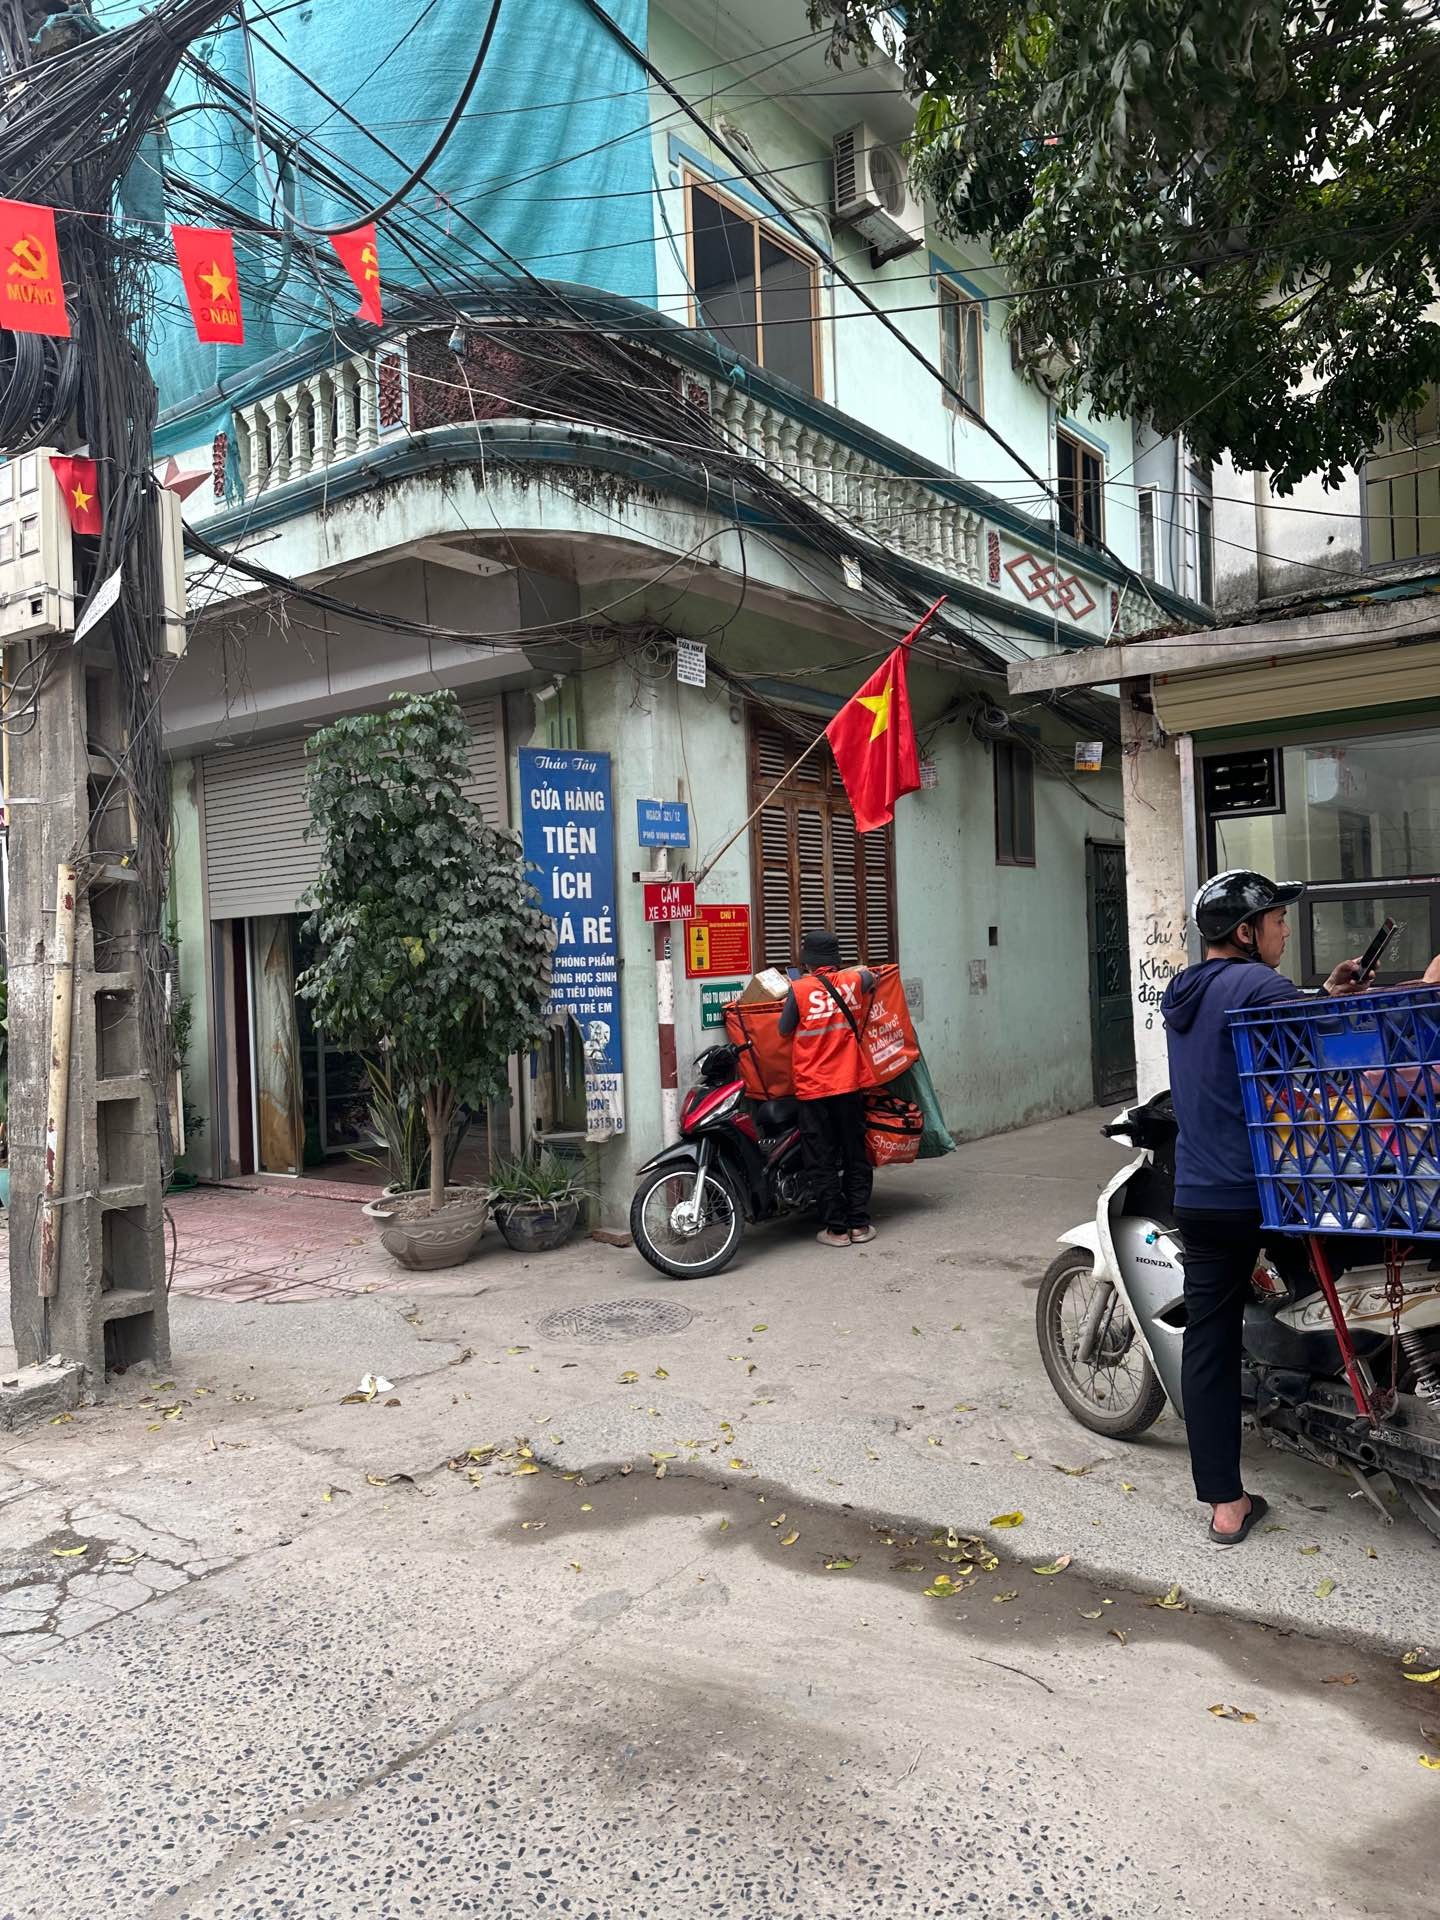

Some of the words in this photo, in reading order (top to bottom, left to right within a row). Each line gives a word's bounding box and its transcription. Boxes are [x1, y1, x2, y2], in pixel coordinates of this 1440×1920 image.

[531, 781, 562, 811] CỬA
[564, 787, 605, 811] HÀNG
[543, 821, 597, 860] TIỆN
[552, 866, 592, 899] ÍCH
[648, 906, 659, 920] XE
[662, 905, 668, 919] 3
[671, 903, 692, 918] BÁNH
[583, 905, 613, 944] RẺ
[1146, 920, 1173, 946] chú
[575, 972, 593, 985] HỌC
[595, 971, 617, 983] SINH
[566, 985, 586, 998] TIÊU
[588, 984, 613, 998] DÙNG
[580, 999, 596, 1014] TRẺ
[598, 1002, 612, 1013] EM
[600, 1080, 617, 1091] 321
[1135, 1256, 1173, 1270] HONDA
